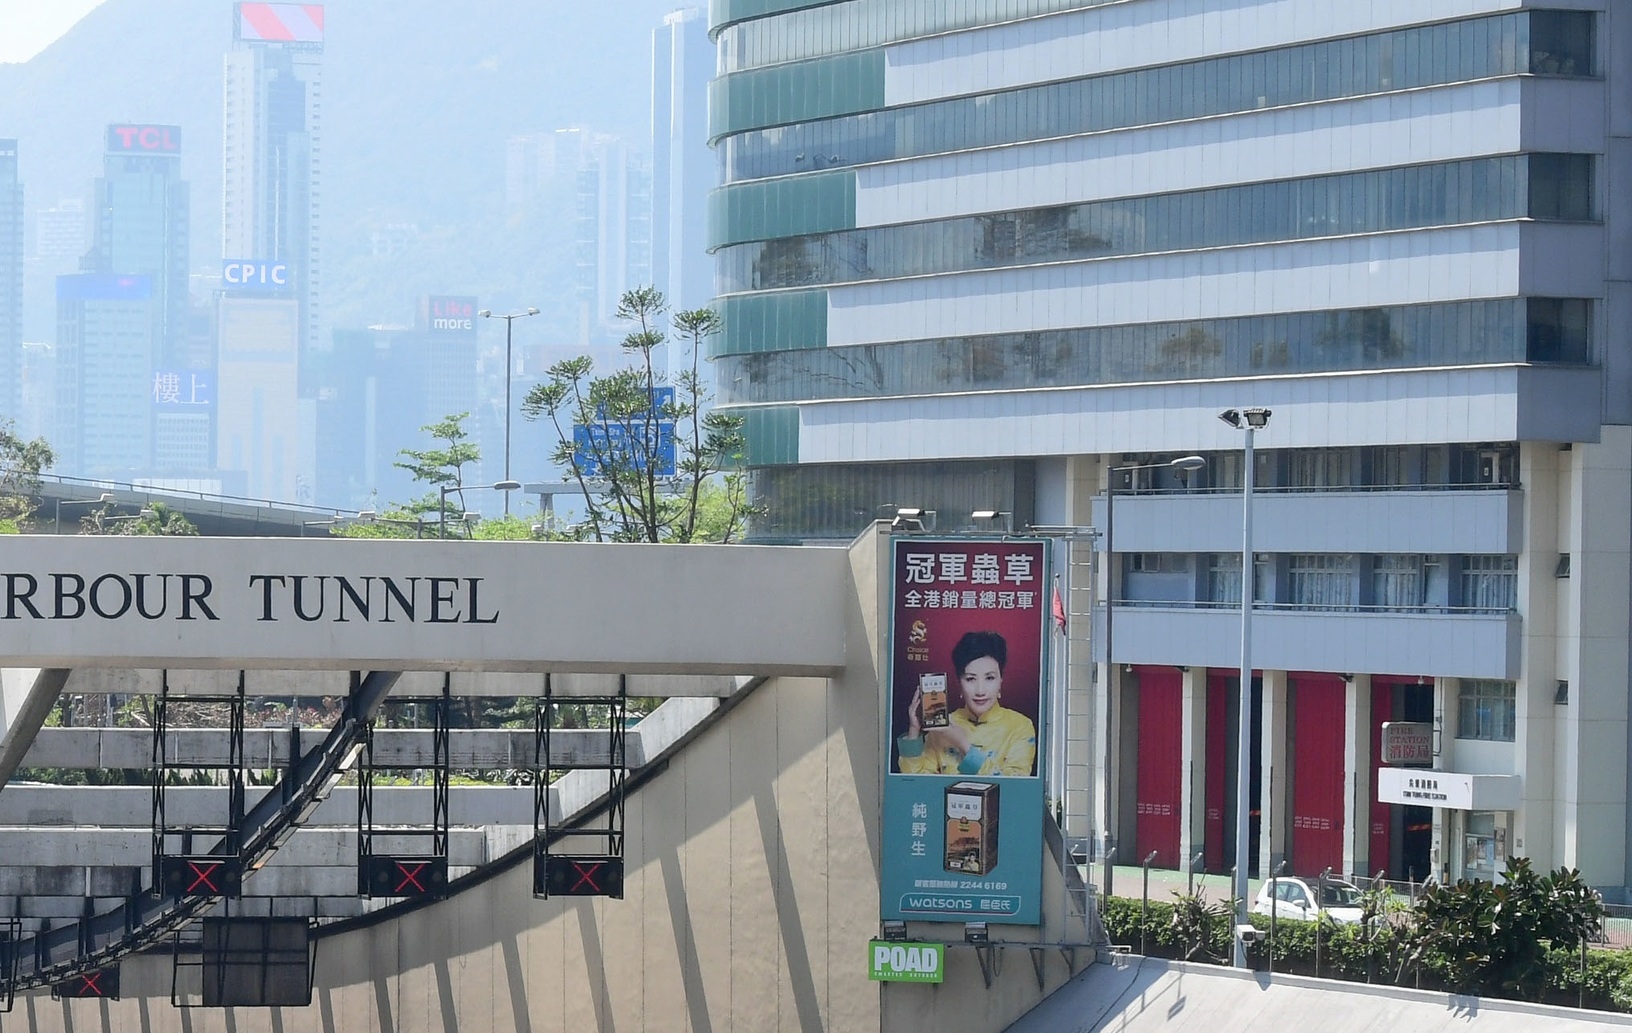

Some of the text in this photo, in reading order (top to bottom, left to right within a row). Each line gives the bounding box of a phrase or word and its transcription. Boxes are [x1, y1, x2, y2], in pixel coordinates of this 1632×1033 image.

[115, 127, 178, 150] TCL
[224, 263, 287, 285] CPIC
[433, 318, 472, 330] more
[151, 371, 210, 405] 樓上
[905, 552, 1034, 586] 冠軍蟲草
[249, 573, 500, 625] TUNNEL
[904, 589, 1034, 610] 全港銷量總冠軍
[1390, 727, 1414, 735] FIRE
[1390, 736, 1430, 744] STATION
[1390, 744, 1429, 759] 消防局
[911, 803, 928, 857] 純野生
[960, 881, 983, 890] 2244
[984, 882, 1008, 891] 6169
[909, 897, 1011, 911] watsons 屈臣氏
[874, 946, 938, 973] POAD
